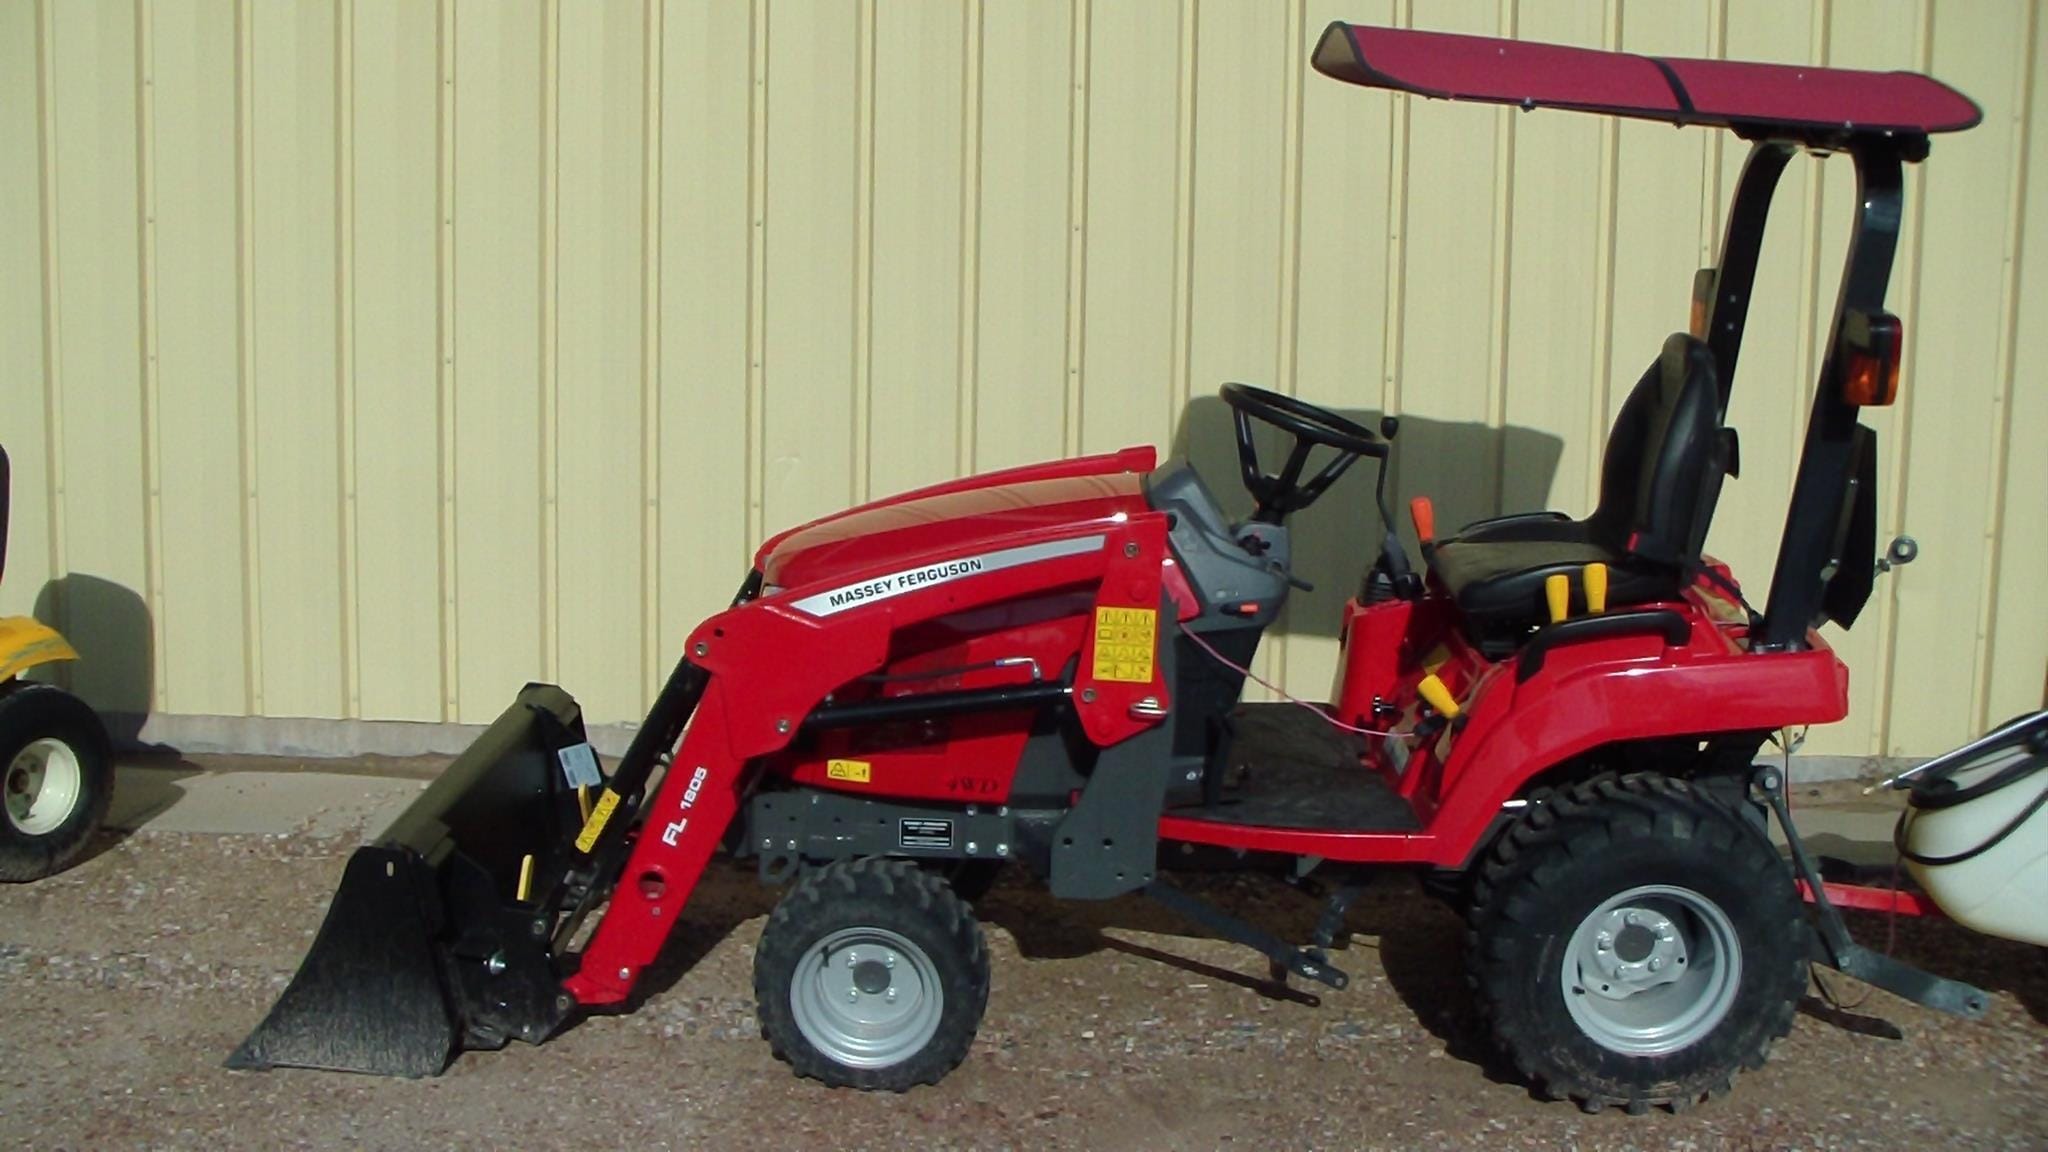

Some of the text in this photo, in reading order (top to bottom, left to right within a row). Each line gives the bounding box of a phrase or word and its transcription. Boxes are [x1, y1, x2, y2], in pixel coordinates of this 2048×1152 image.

[829, 558, 982, 607] MASSEY FERGUSON
[662, 766, 707, 846] FL 1805
